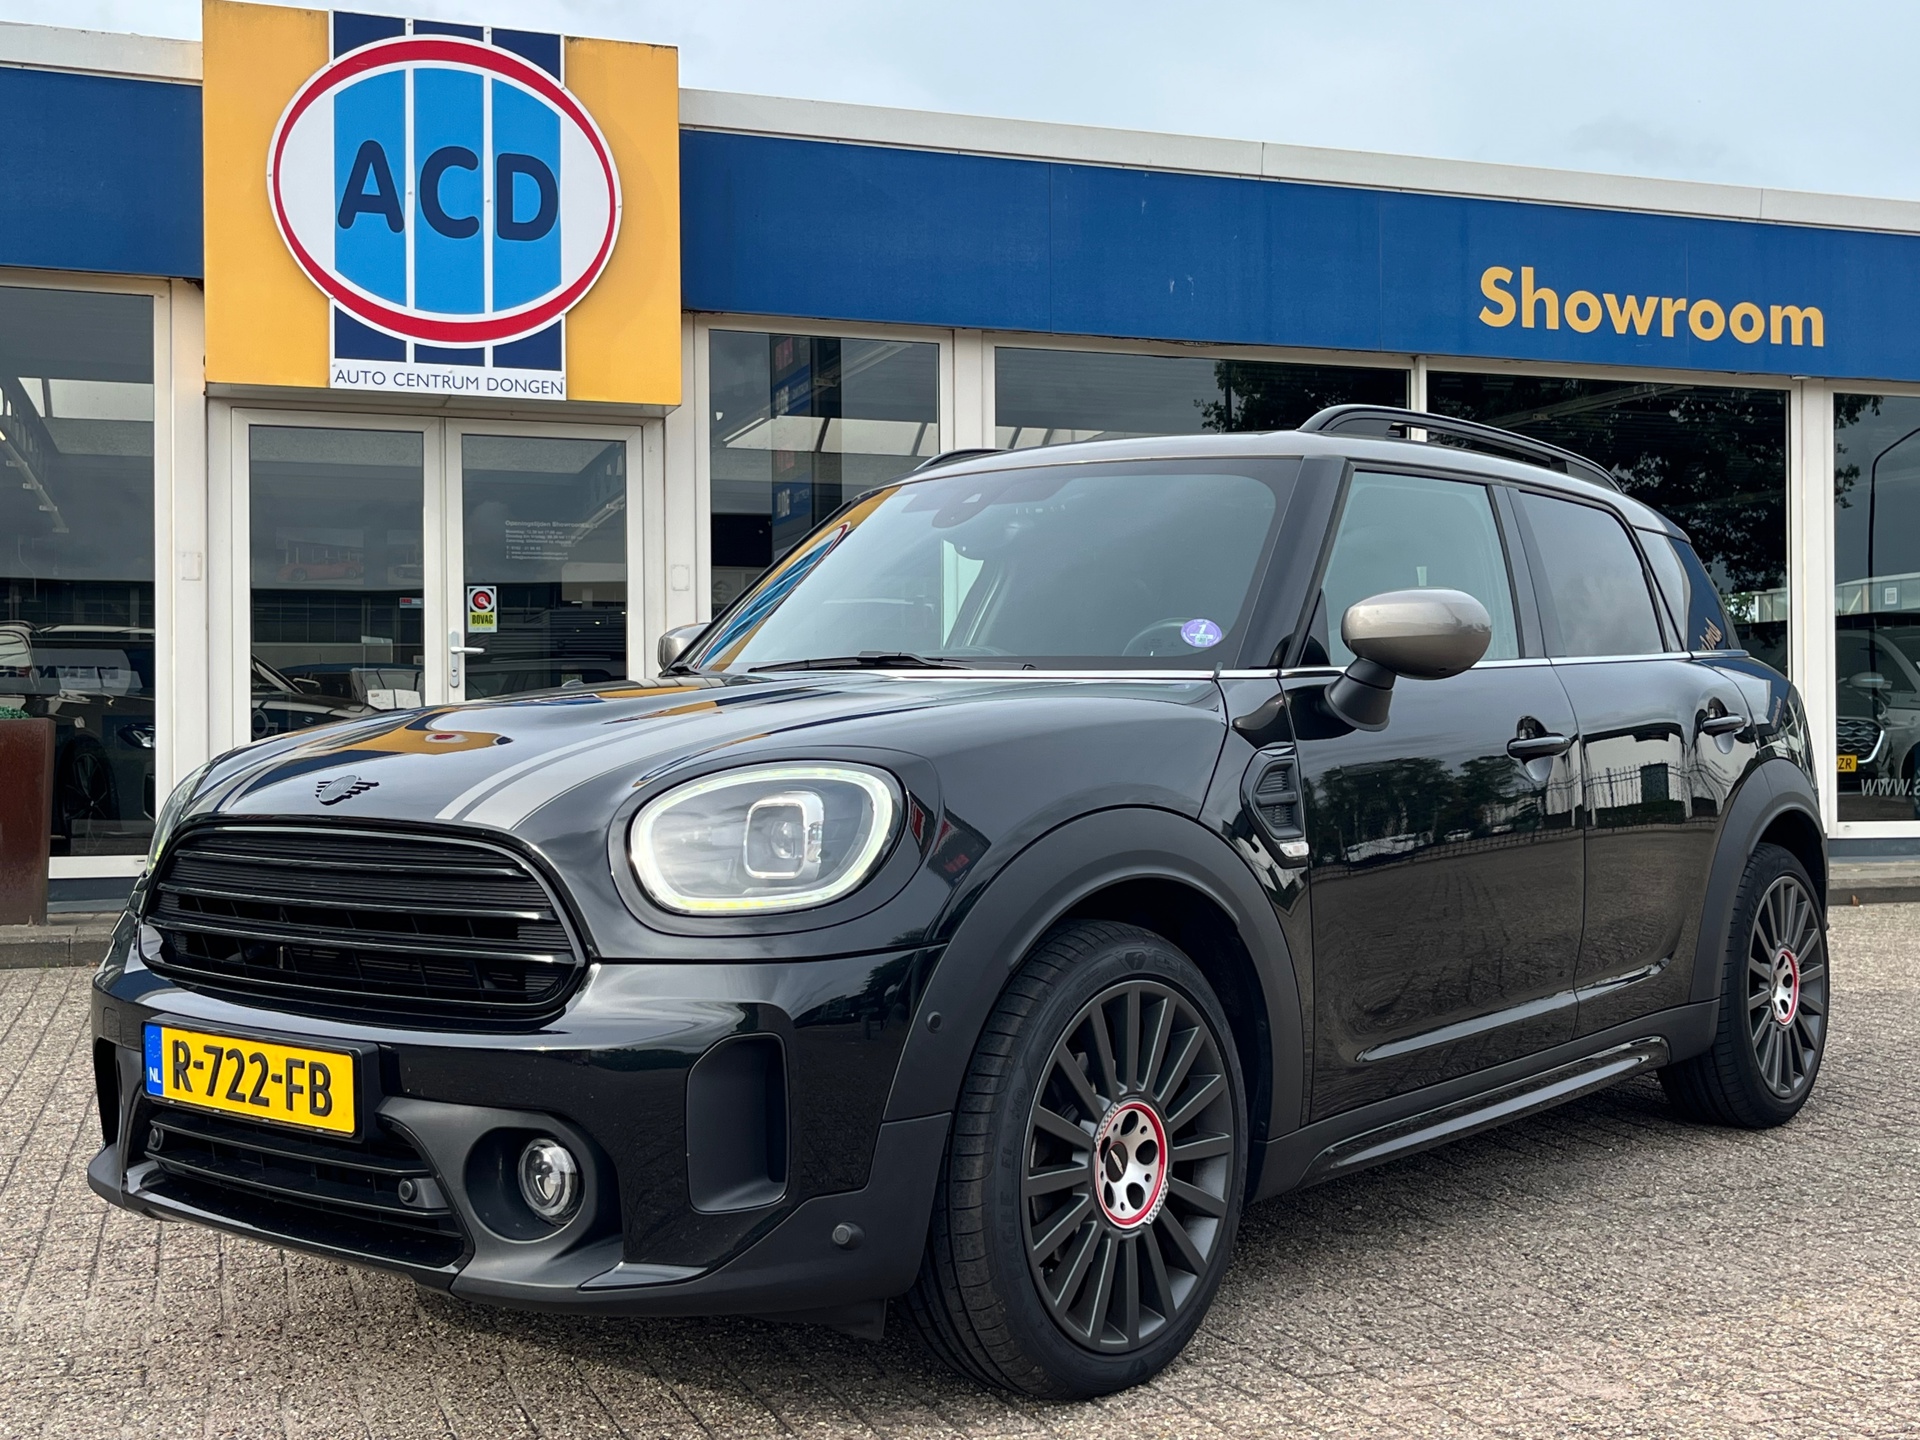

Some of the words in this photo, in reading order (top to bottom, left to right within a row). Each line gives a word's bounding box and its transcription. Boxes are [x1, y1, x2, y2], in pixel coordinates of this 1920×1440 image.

[337, 140, 559, 241] ACD
[1479, 266, 1824, 347] Showroom
[334, 369, 387, 385] AUTO
[393, 372, 480, 391] CENTRUM
[486, 377, 564, 395] DONGEN
[471, 614, 494, 625] BOVAG
[149, 1067, 162, 1084] NL
[172, 1040, 333, 1117] R-722-FB
